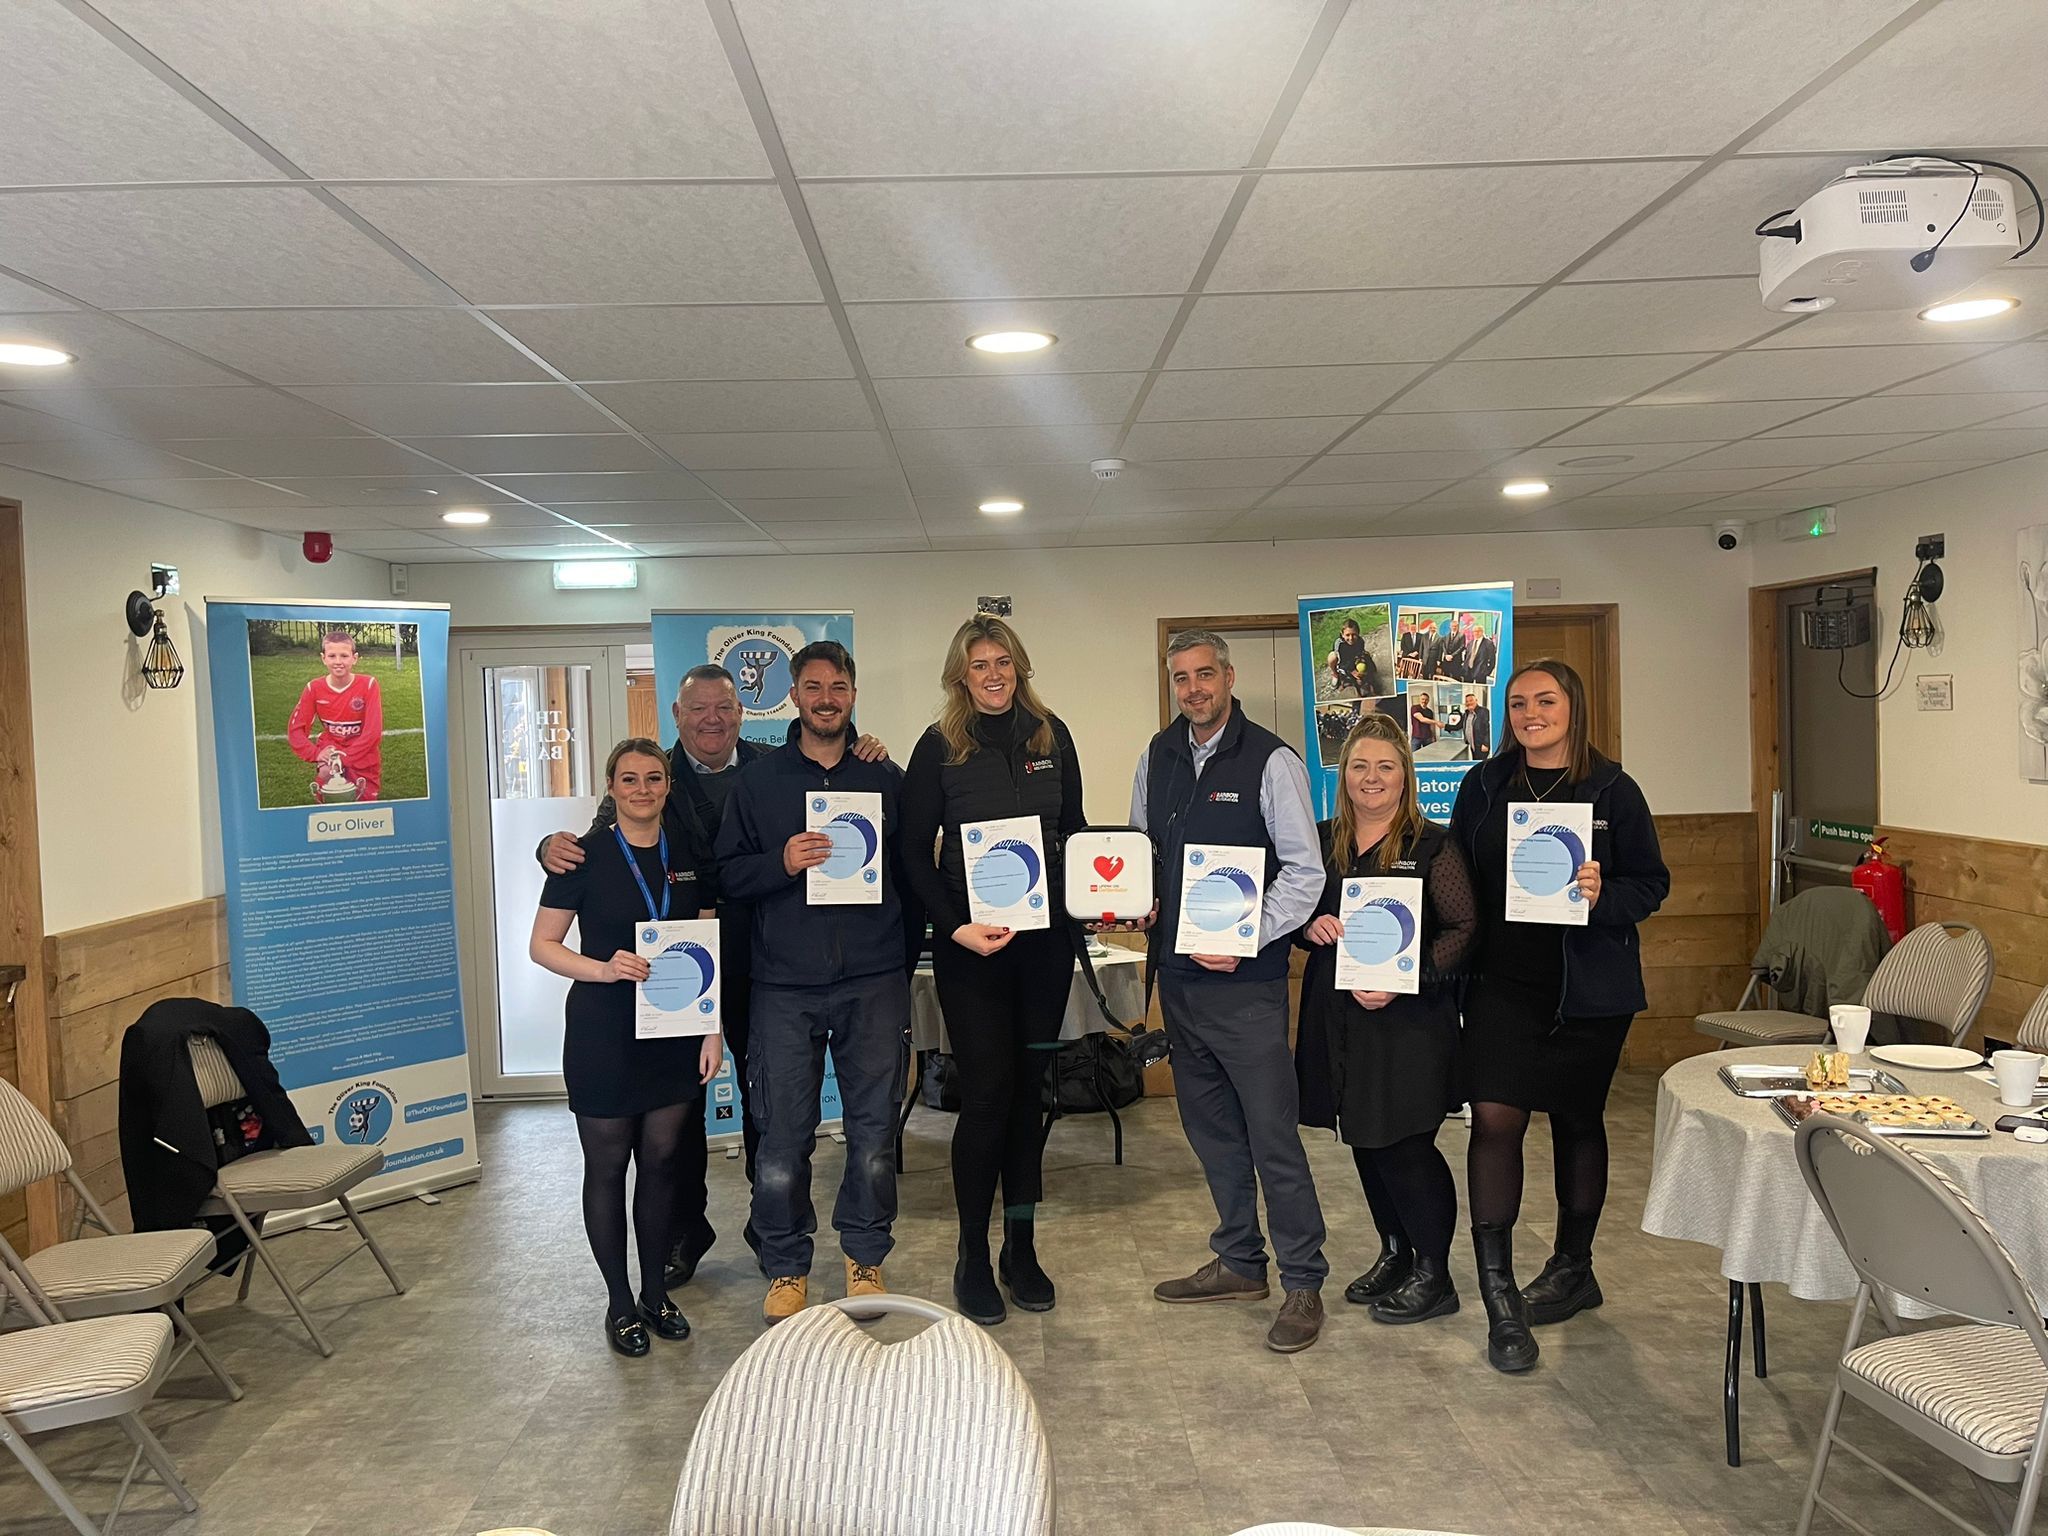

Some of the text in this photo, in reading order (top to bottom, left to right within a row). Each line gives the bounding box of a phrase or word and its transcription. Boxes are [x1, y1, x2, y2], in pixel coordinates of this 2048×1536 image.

[714, 629, 796, 661] The Oliver King Foundat
[329, 726, 360, 736] ECHO
[316, 817, 384, 832] Our Oliver
[1821, 825, 1873, 843] Push bar to ope
[328, 1080, 398, 1115] The Oliver King Foundation
[406, 1100, 466, 1118] @TheOKFoundation
